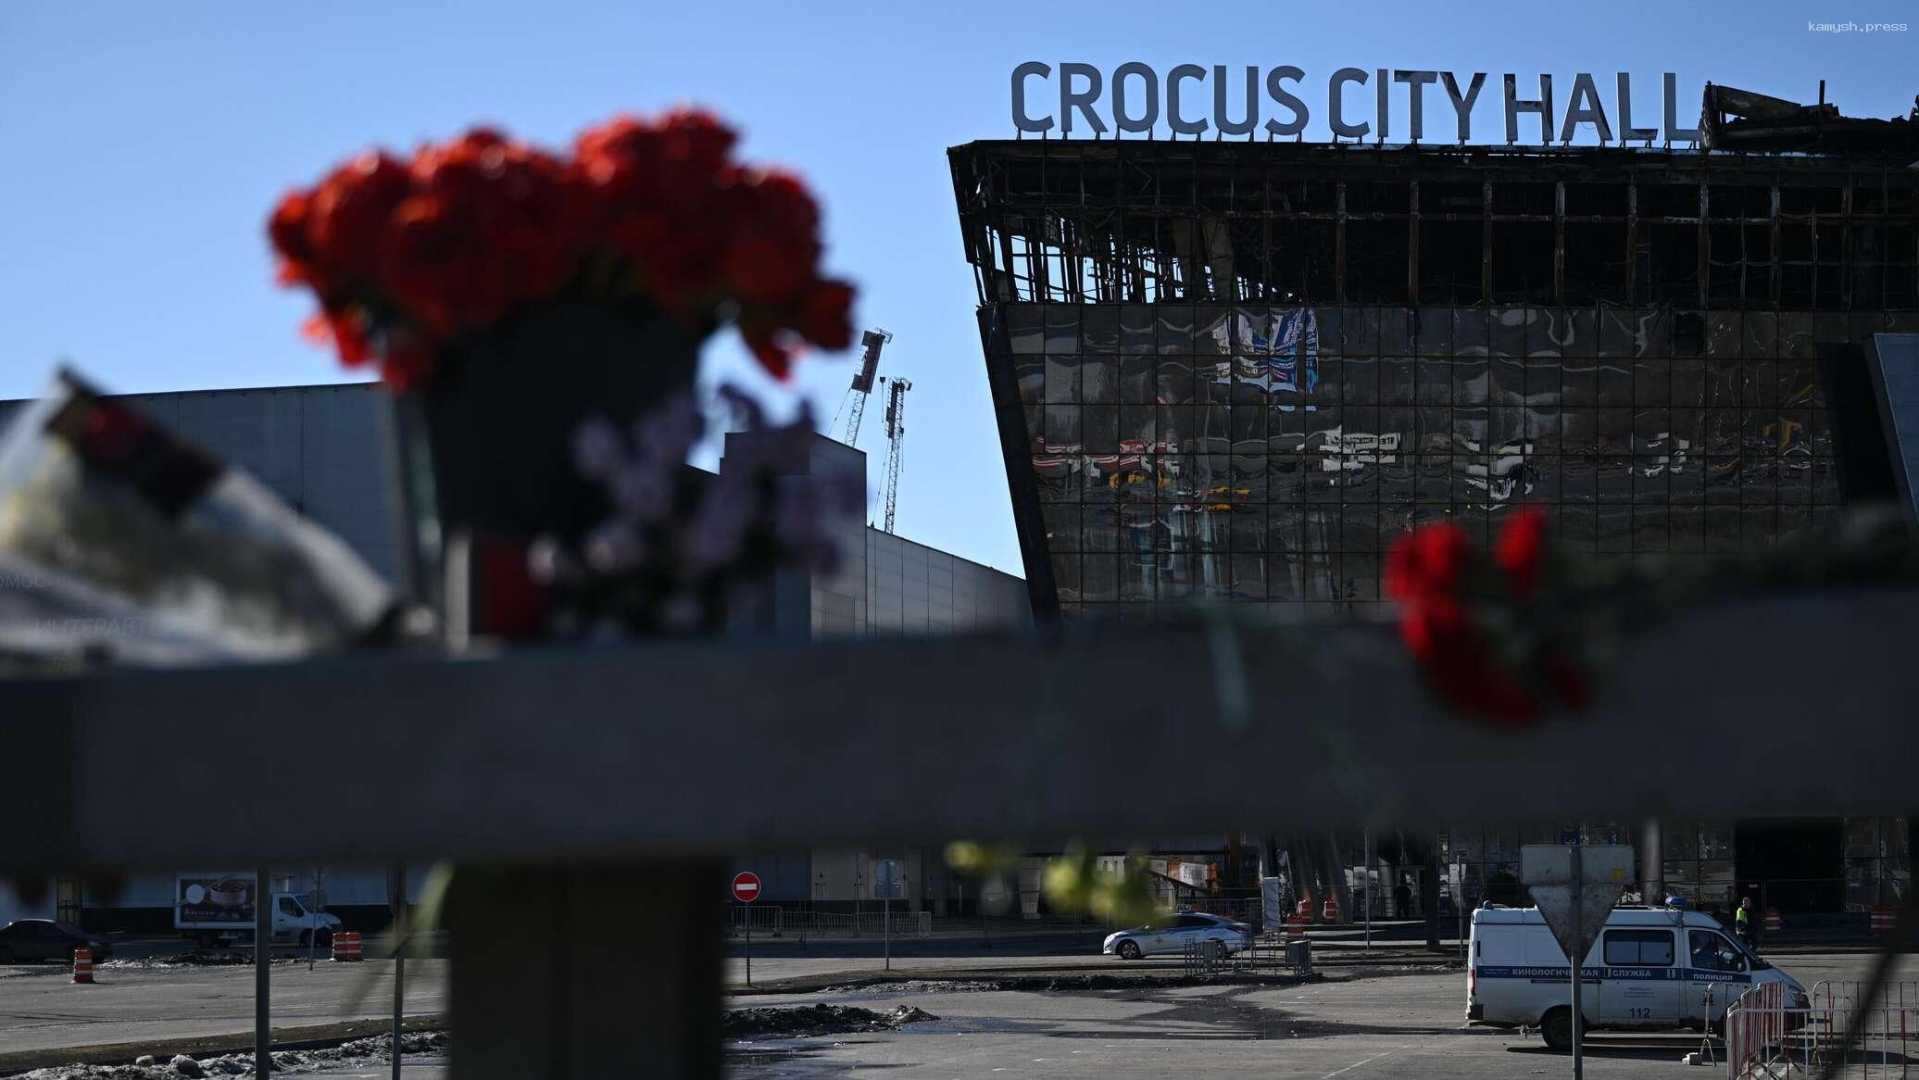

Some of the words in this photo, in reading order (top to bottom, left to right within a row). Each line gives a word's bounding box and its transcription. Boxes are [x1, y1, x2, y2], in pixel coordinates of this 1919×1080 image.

[1011, 61, 1310, 137] CROCUS
[1328, 67, 1487, 142] CITY
[1502, 71, 1701, 144] HALL
[1693, 973, 1733, 982] ПОЛИЦИЯ
[1630, 1007, 1650, 1019] 112
